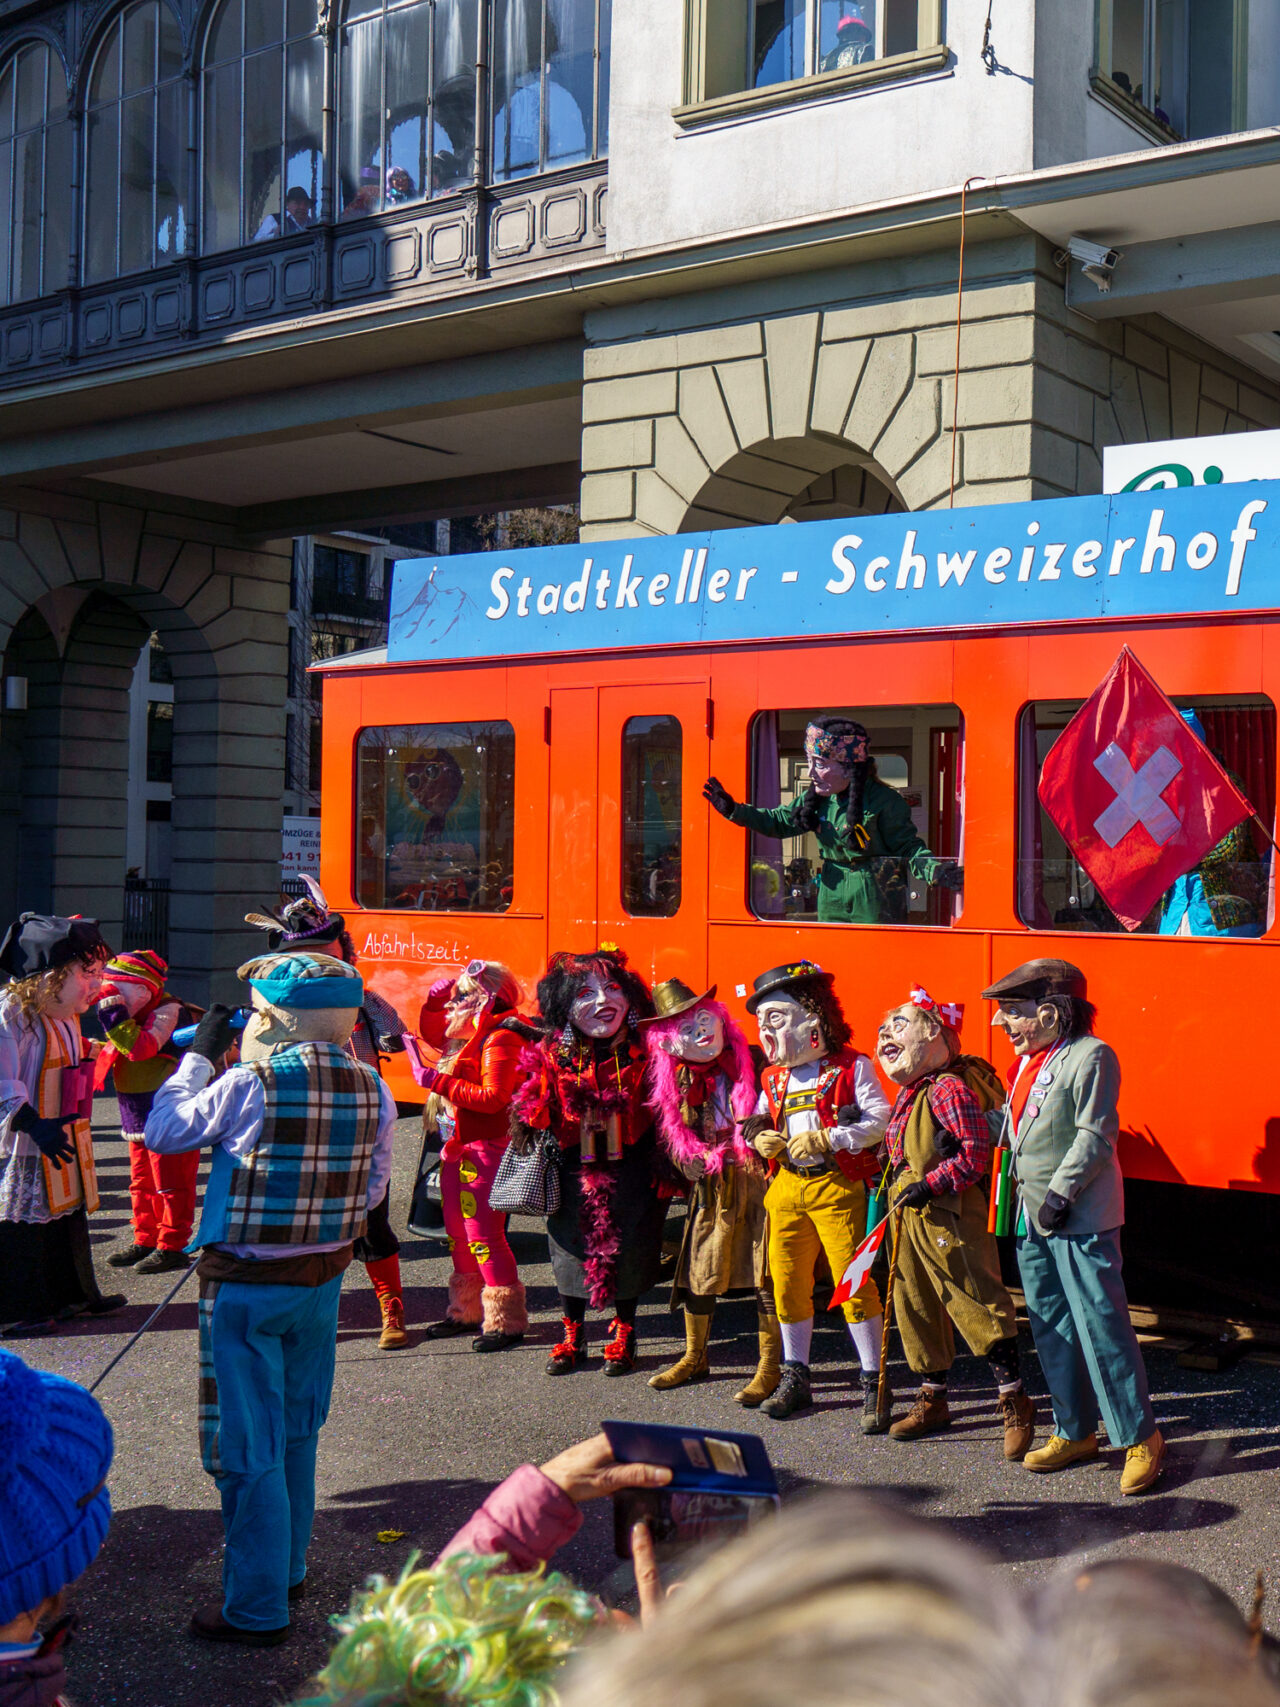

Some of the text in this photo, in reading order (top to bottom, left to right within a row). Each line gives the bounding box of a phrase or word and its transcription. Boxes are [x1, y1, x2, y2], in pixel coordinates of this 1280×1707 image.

[485, 547, 758, 621] Stadtkeller
[825, 499, 1268, 596] Schweizerhof
[363, 931, 470, 962] Abfahrtszeit:
